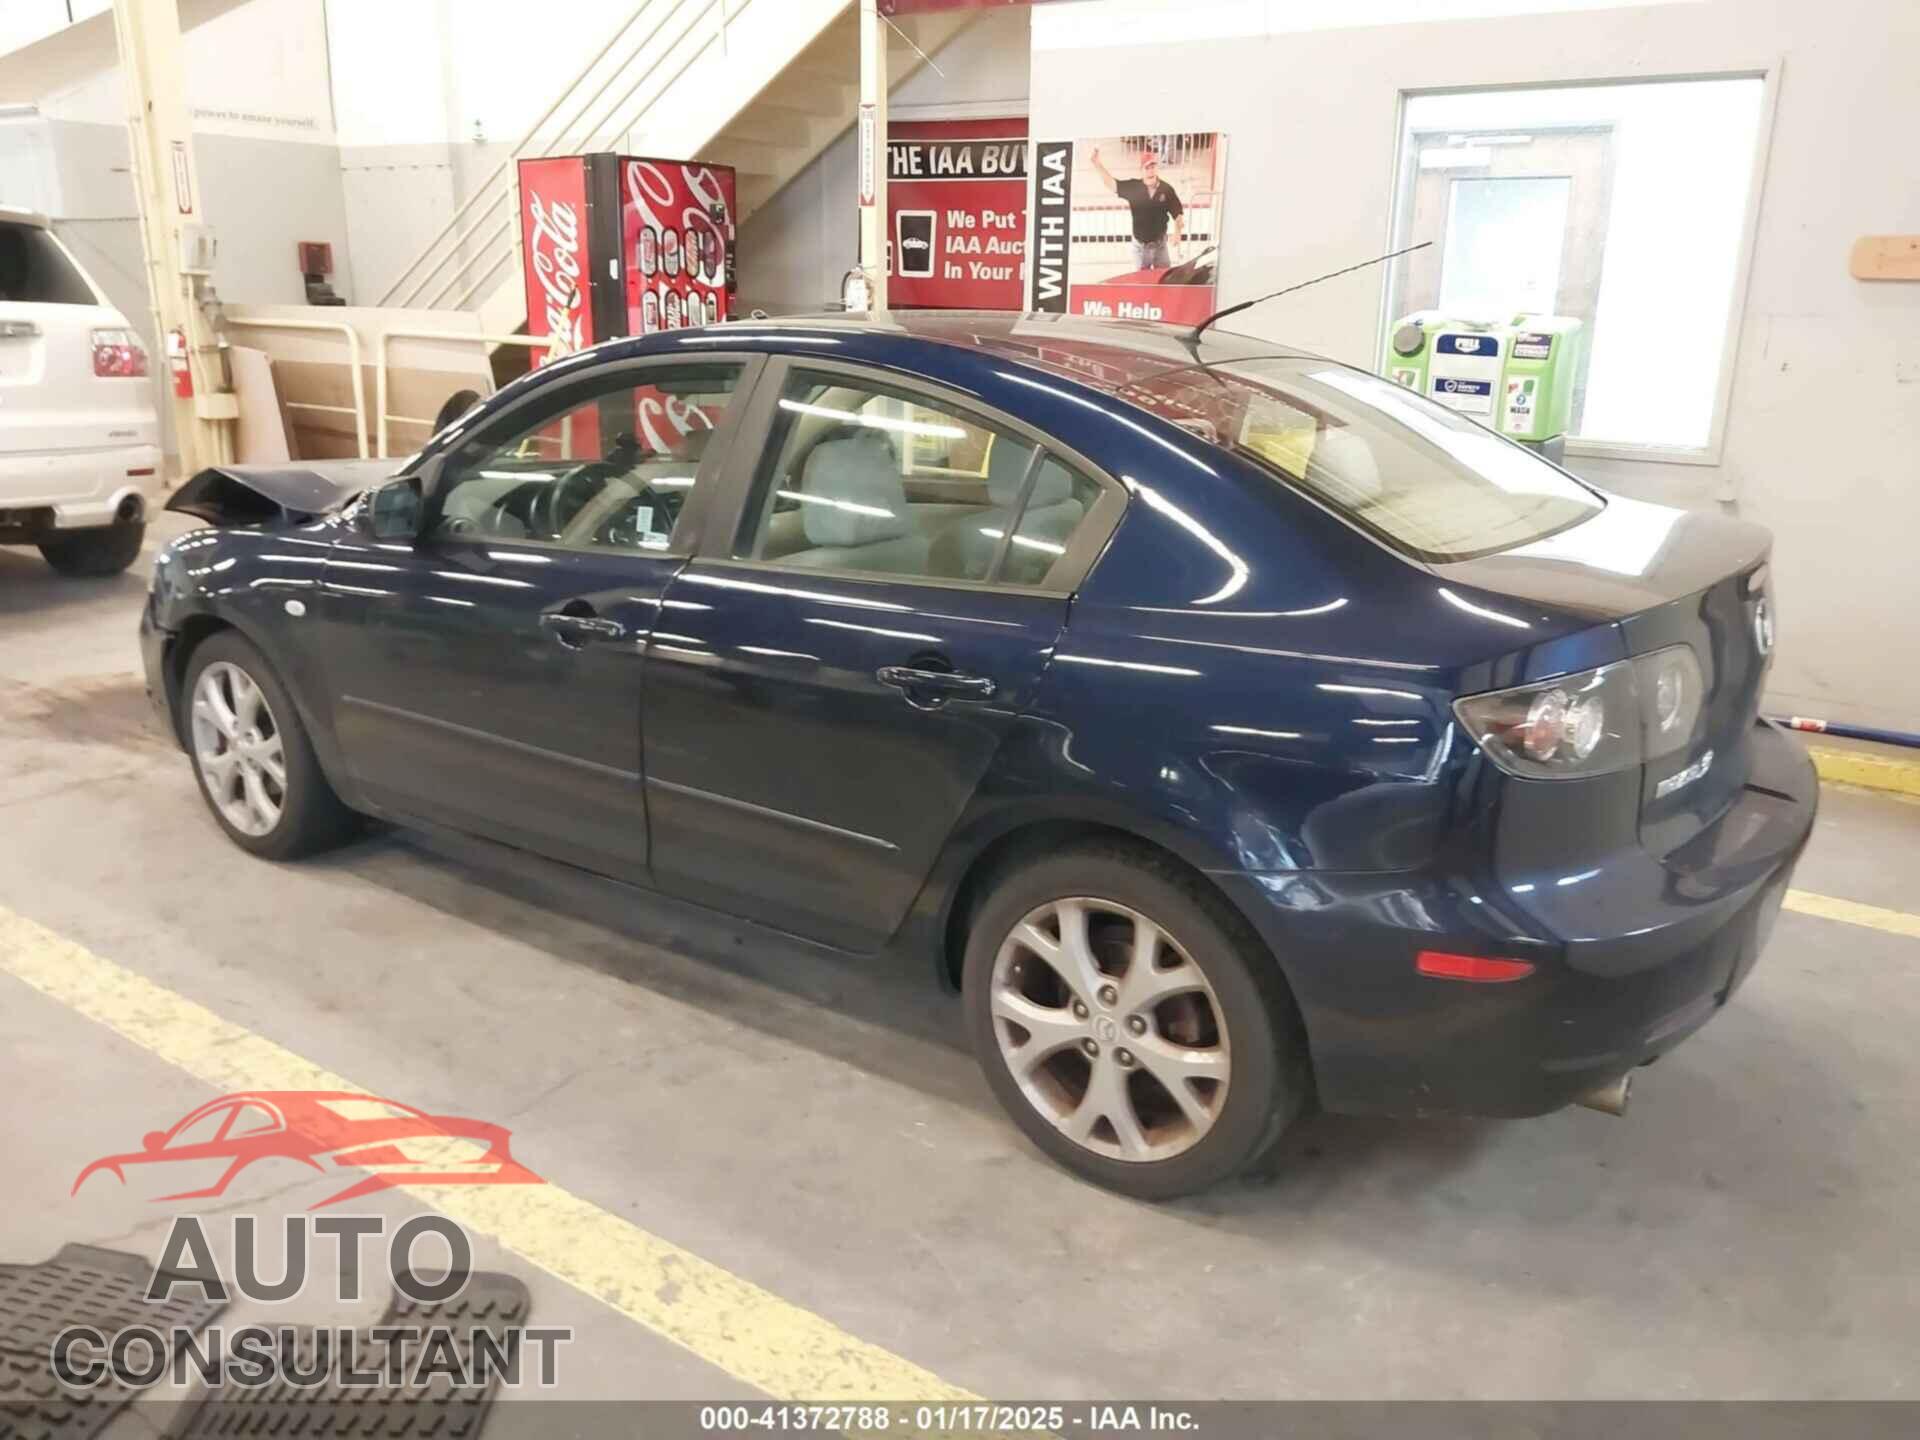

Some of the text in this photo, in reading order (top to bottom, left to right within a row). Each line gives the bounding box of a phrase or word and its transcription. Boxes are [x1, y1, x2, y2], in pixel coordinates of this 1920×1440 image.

[929, 146, 974, 175] IAA
[947, 210, 1017, 229] We Put
[1038, 149, 1067, 300] WITH IAA
[946, 235, 982, 254] IAA
[944, 261, 962, 280] In
[969, 261, 1013, 281] Your
[1083, 301, 1162, 320] We Help
